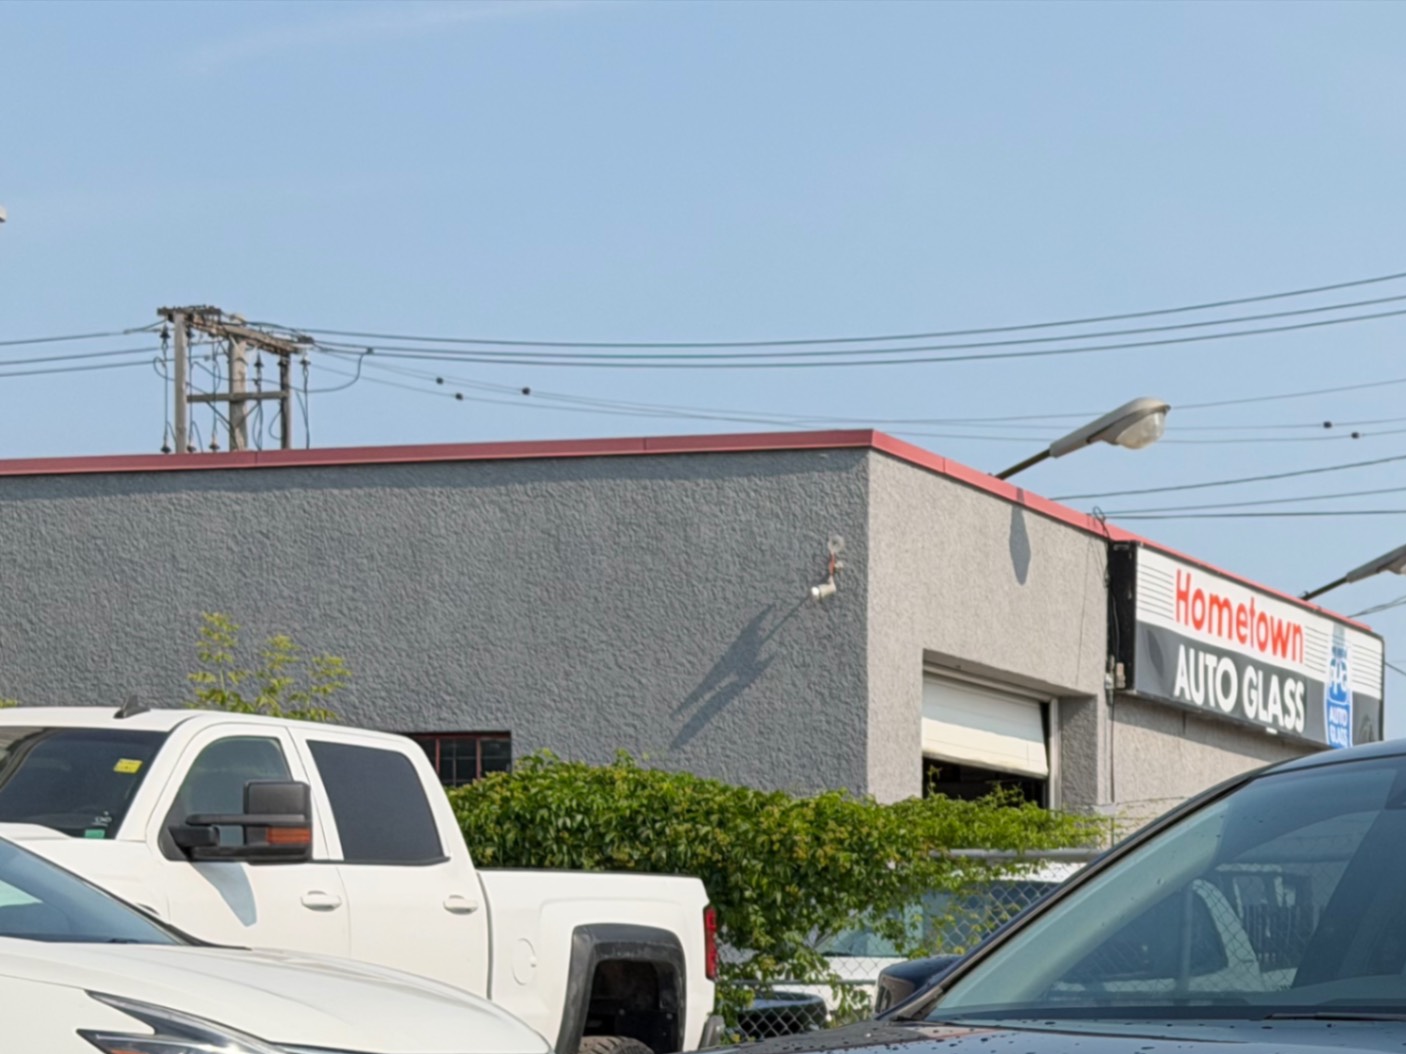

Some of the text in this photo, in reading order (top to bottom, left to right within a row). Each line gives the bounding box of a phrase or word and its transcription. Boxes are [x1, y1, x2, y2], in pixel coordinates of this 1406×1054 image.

[1175, 568, 1304, 664] Hometown
[1174, 644, 1305, 733] AUTO GLASS
